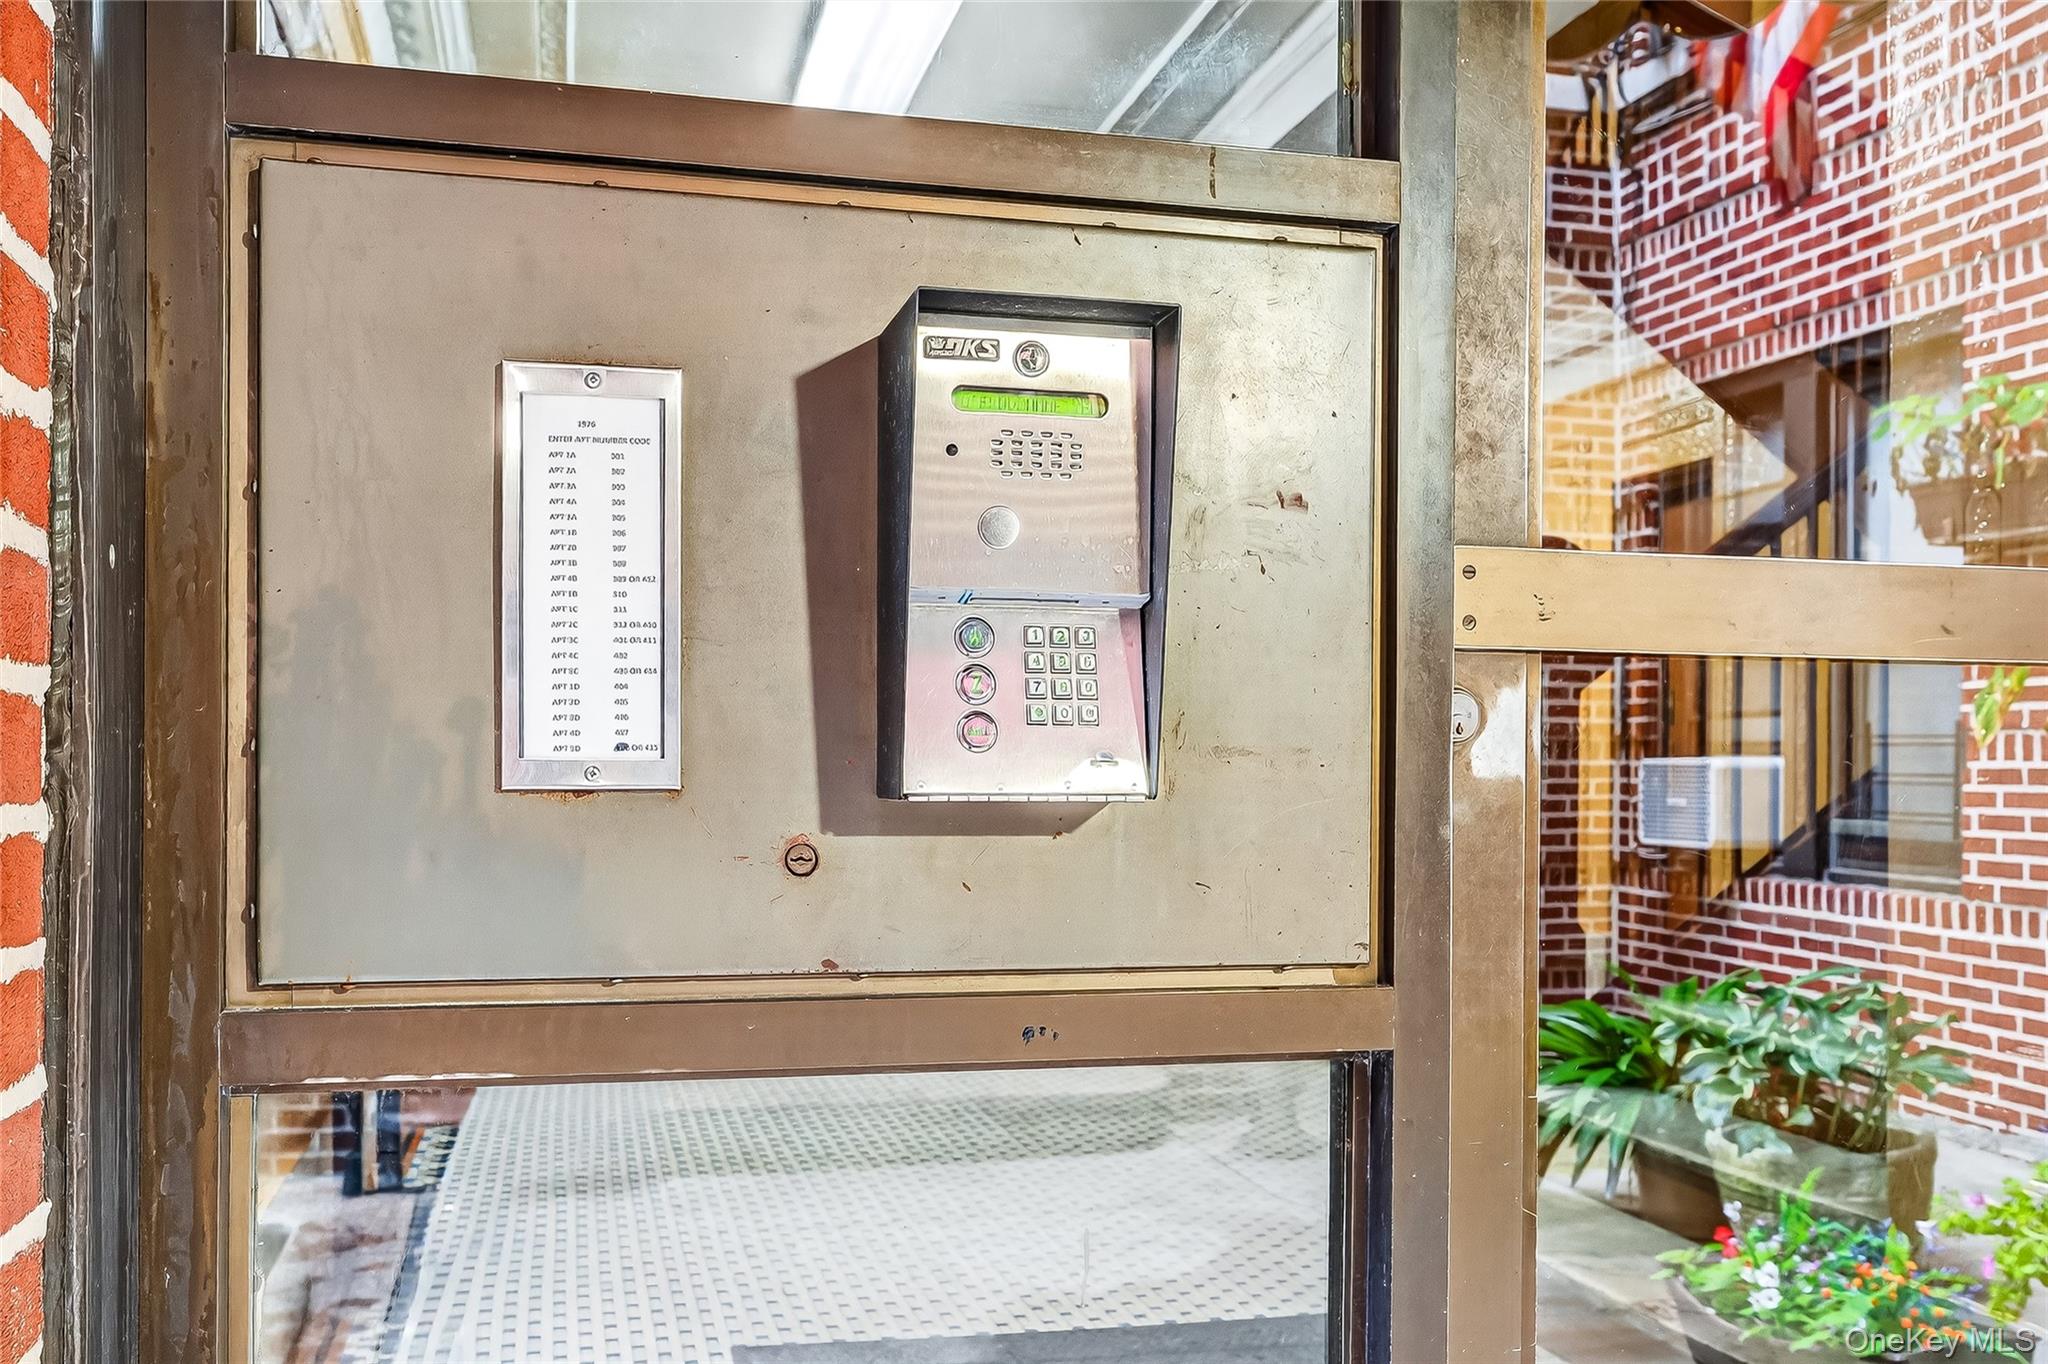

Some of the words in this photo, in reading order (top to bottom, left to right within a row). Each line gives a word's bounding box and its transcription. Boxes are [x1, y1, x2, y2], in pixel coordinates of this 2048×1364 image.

[629, 438, 651, 446] CODE
[548, 451, 564, 459] APT
[548, 466, 564, 474] APT
[549, 482, 564, 490] APT
[549, 498, 564, 506] APT
[549, 513, 564, 521] APT
[549, 528, 565, 536] APT
[550, 544, 565, 552] APT
[550, 559, 565, 567] APT
[550, 574, 566, 582] APT
[550, 590, 566, 598] APT
[551, 605, 566, 613] APT
[551, 621, 566, 629] APT
[551, 636, 567, 644] APT
[551, 652, 567, 660] APT
[552, 667, 567, 675] APT
[552, 682, 567, 690] APT
[552, 698, 567, 706] APT
[552, 714, 568, 722] APT
[553, 729, 568, 737] APT
[553, 744, 568, 752] APT
